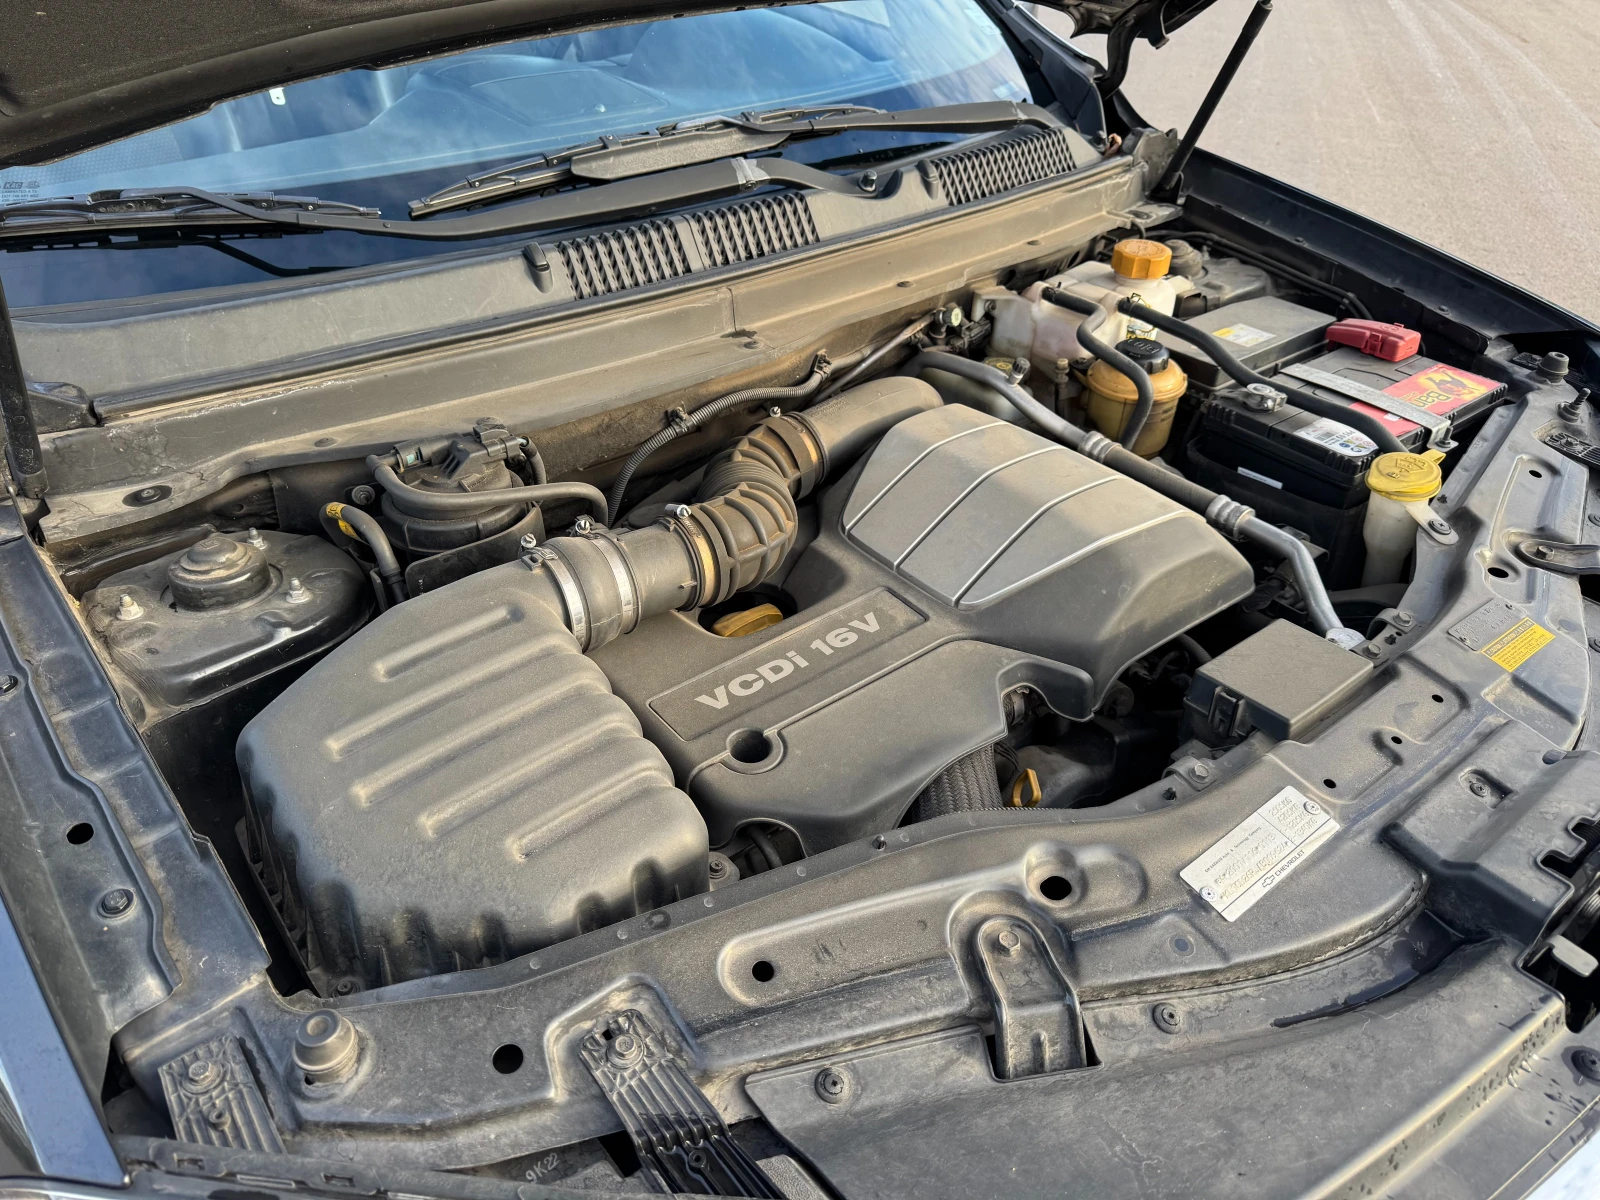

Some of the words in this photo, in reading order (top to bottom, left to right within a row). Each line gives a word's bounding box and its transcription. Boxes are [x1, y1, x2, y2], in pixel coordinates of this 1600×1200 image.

[1406, 390, 1451, 407] Ban
[694, 650, 809, 709] VCDi
[810, 611, 881, 655] 16V
[1275, 849, 1305, 876] CHEVROLET
